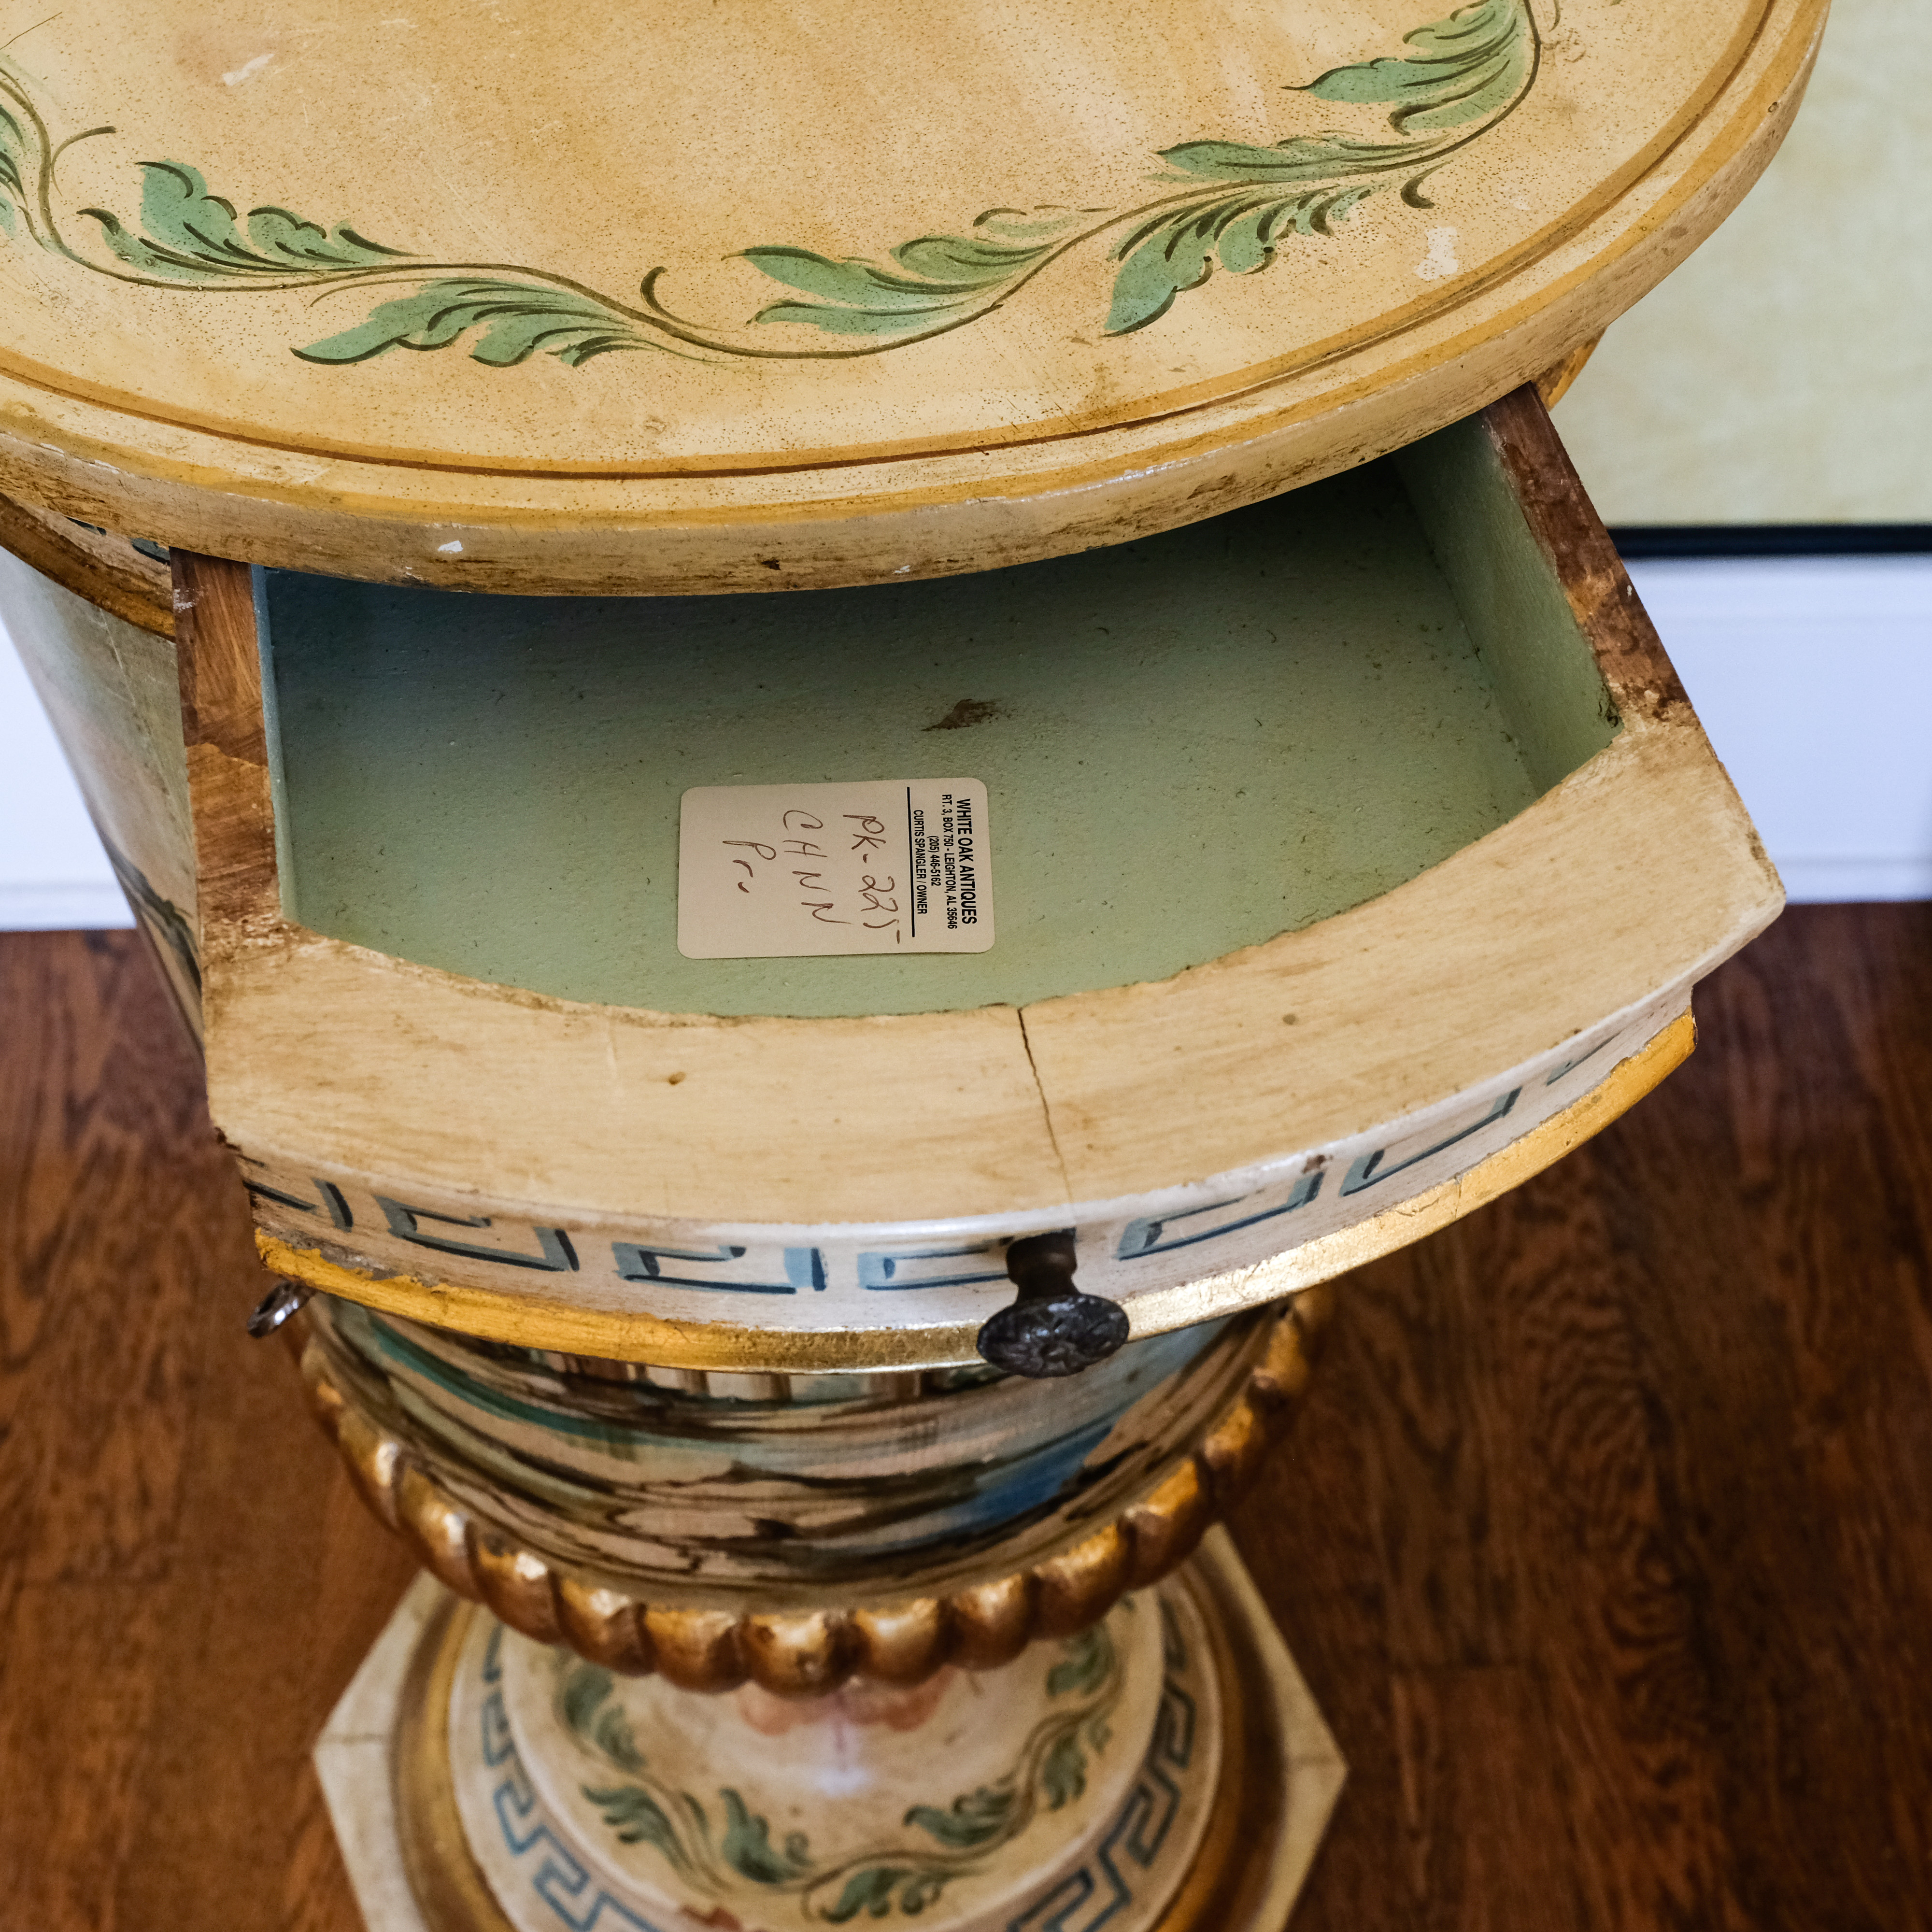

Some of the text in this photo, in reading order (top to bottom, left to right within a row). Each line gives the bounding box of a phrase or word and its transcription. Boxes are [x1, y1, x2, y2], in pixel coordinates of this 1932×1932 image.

[942, 794, 952, 807] RT.
[913, 810, 924, 837] CURTIS
[943, 817, 953, 833] BOX
[943, 834, 954, 846] 750
[914, 838, 926, 879] SPANGLER
[927, 836, 941, 886] (205) 446-5162
[956, 798, 977, 924] WHITE OAK ANTIQUES
[944, 853, 956, 894] LEIGHTON,
[916, 885, 927, 914] OWNER
[946, 895, 957, 906] AL
[947, 907, 958, 929] 35646
